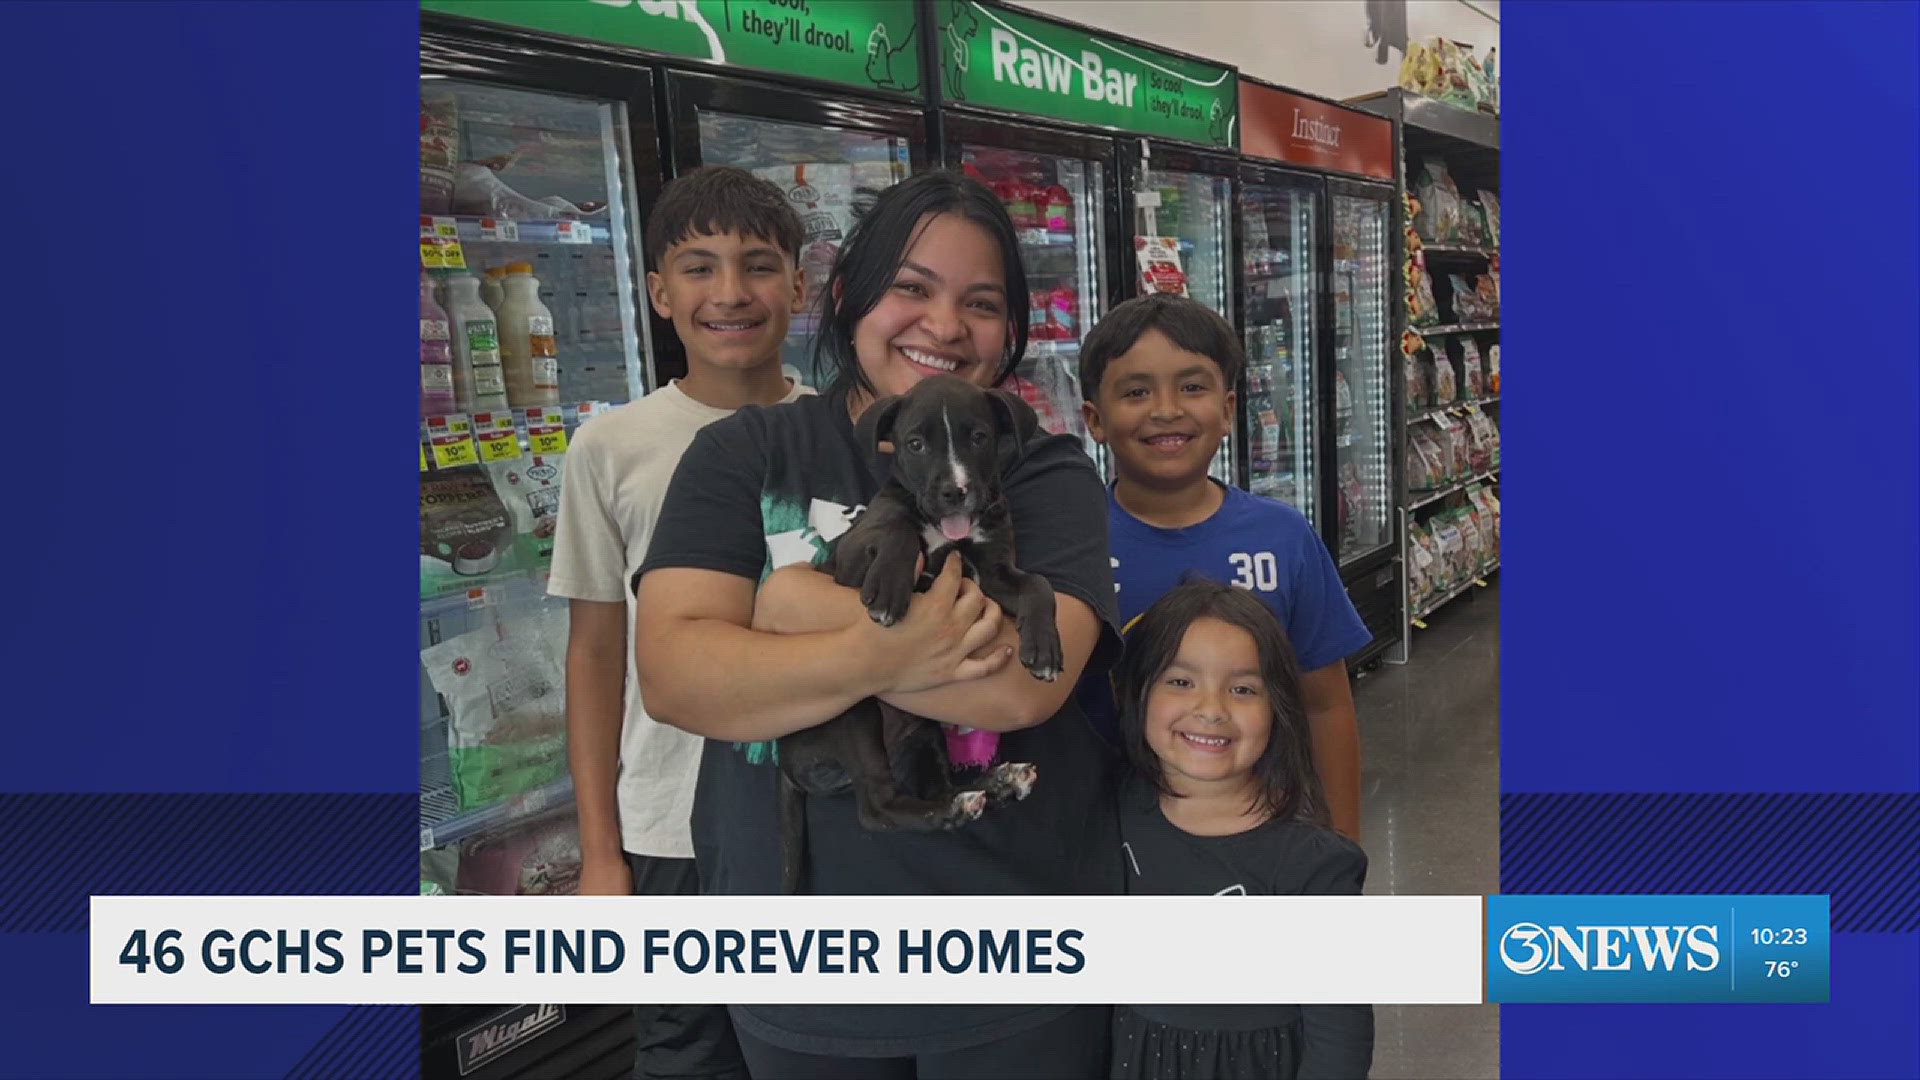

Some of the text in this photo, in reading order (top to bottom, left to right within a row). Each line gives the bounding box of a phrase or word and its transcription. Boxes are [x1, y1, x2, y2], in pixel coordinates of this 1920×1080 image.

[742, 9, 855, 54] they'll drool.
[991, 27, 1137, 108] Raw Bar
[1151, 72, 1184, 97] So cool,
[1291, 108, 1342, 147] Instinct
[1228, 551, 1278, 591] 30
[468, 1004, 560, 1059] Migali
